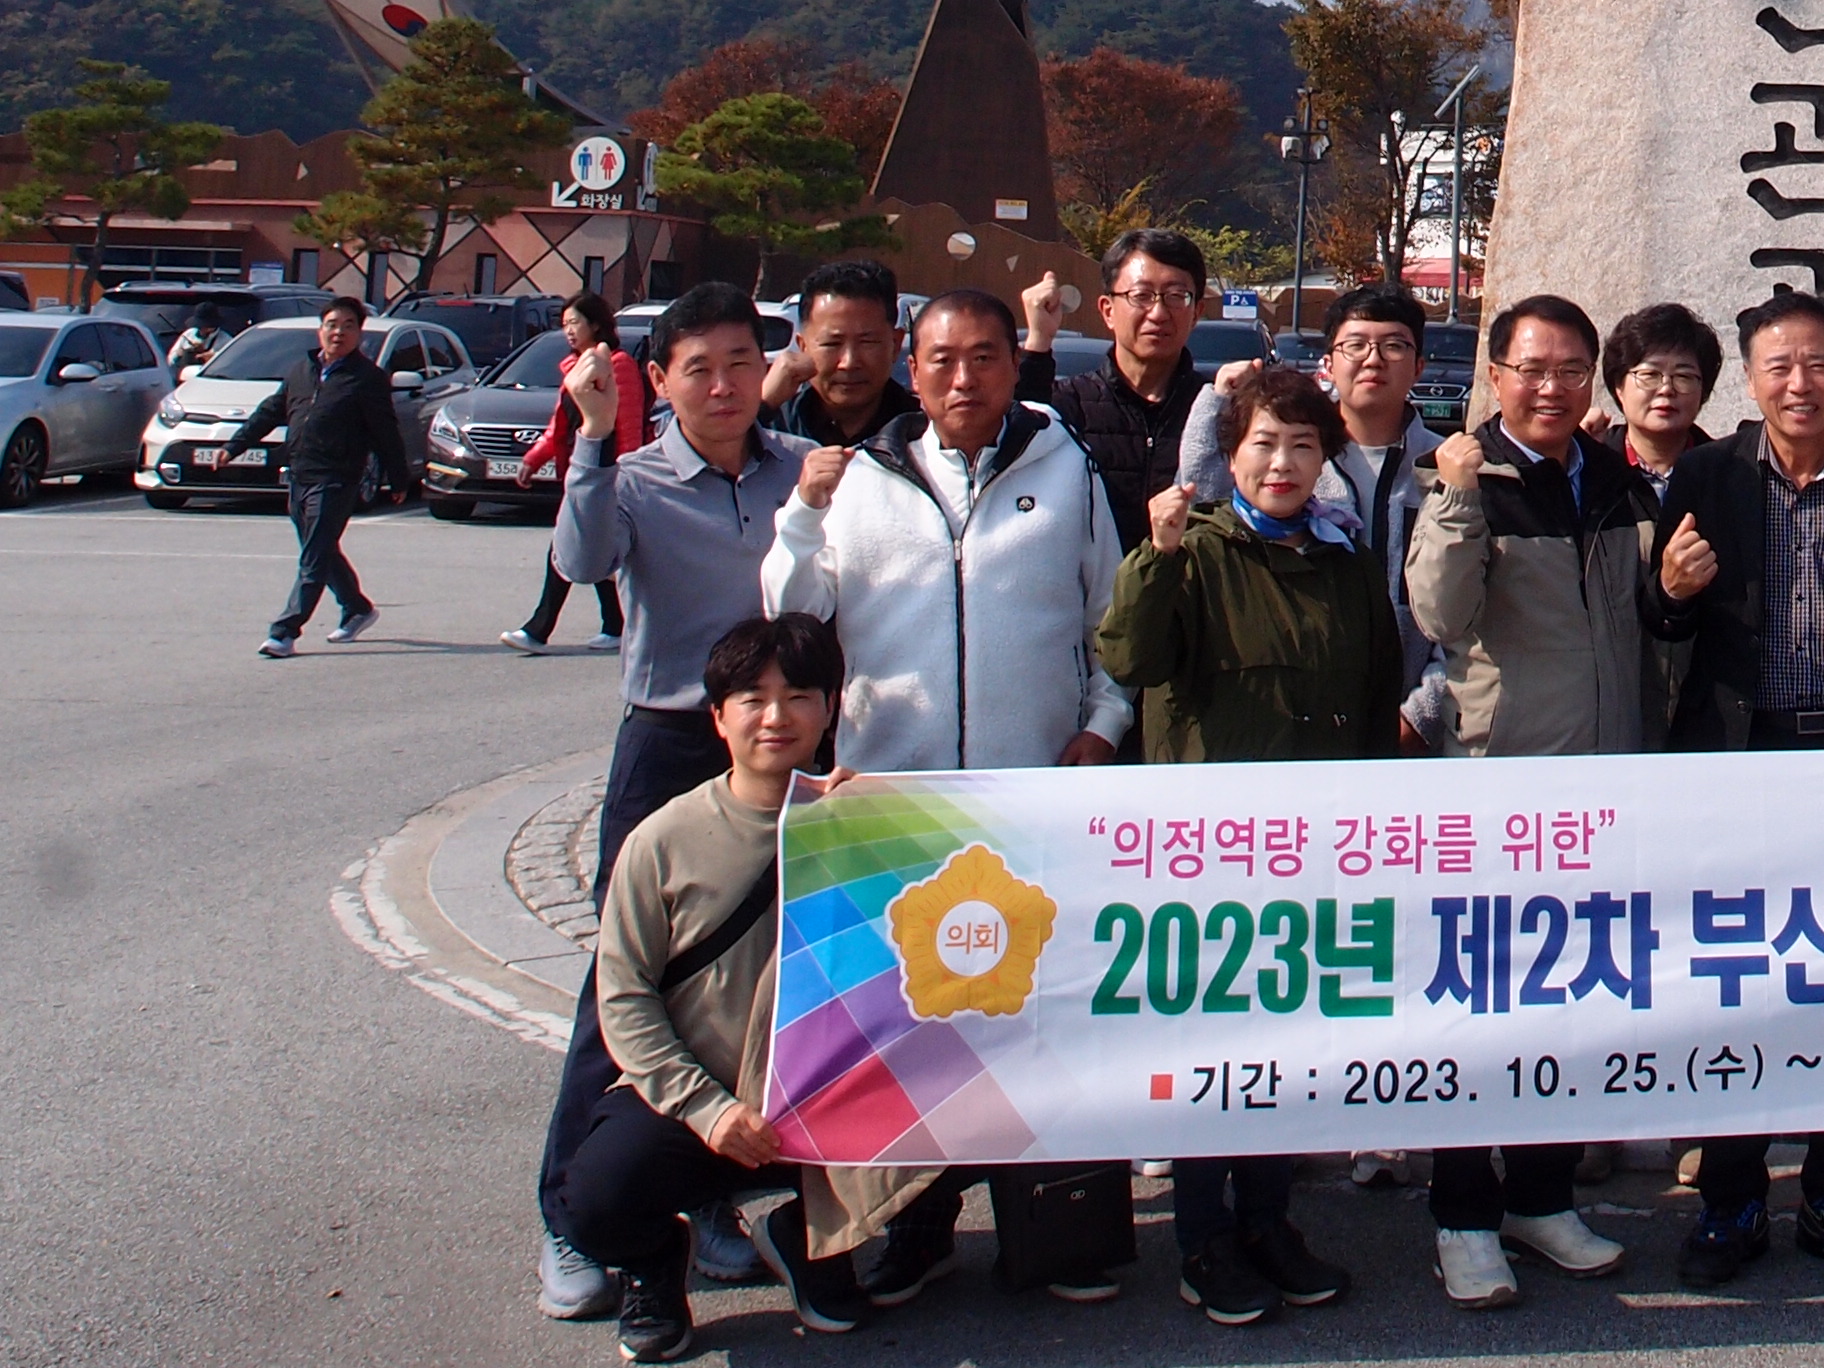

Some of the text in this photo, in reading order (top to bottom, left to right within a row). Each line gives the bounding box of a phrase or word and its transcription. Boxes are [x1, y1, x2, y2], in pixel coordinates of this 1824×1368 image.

[581, 194, 622, 209] 화장실
[1231, 294, 1240, 305] P
[1089, 809, 1615, 879] “의정역량 강화를 위한”
[945, 922, 998, 954] 의회
[1091, 897, 1395, 1017] 2023년
[1423, 891, 1660, 1014] 제2차
[1189, 1060, 1282, 1112] 기간
[1343, 1059, 1477, 1105] 2023.
